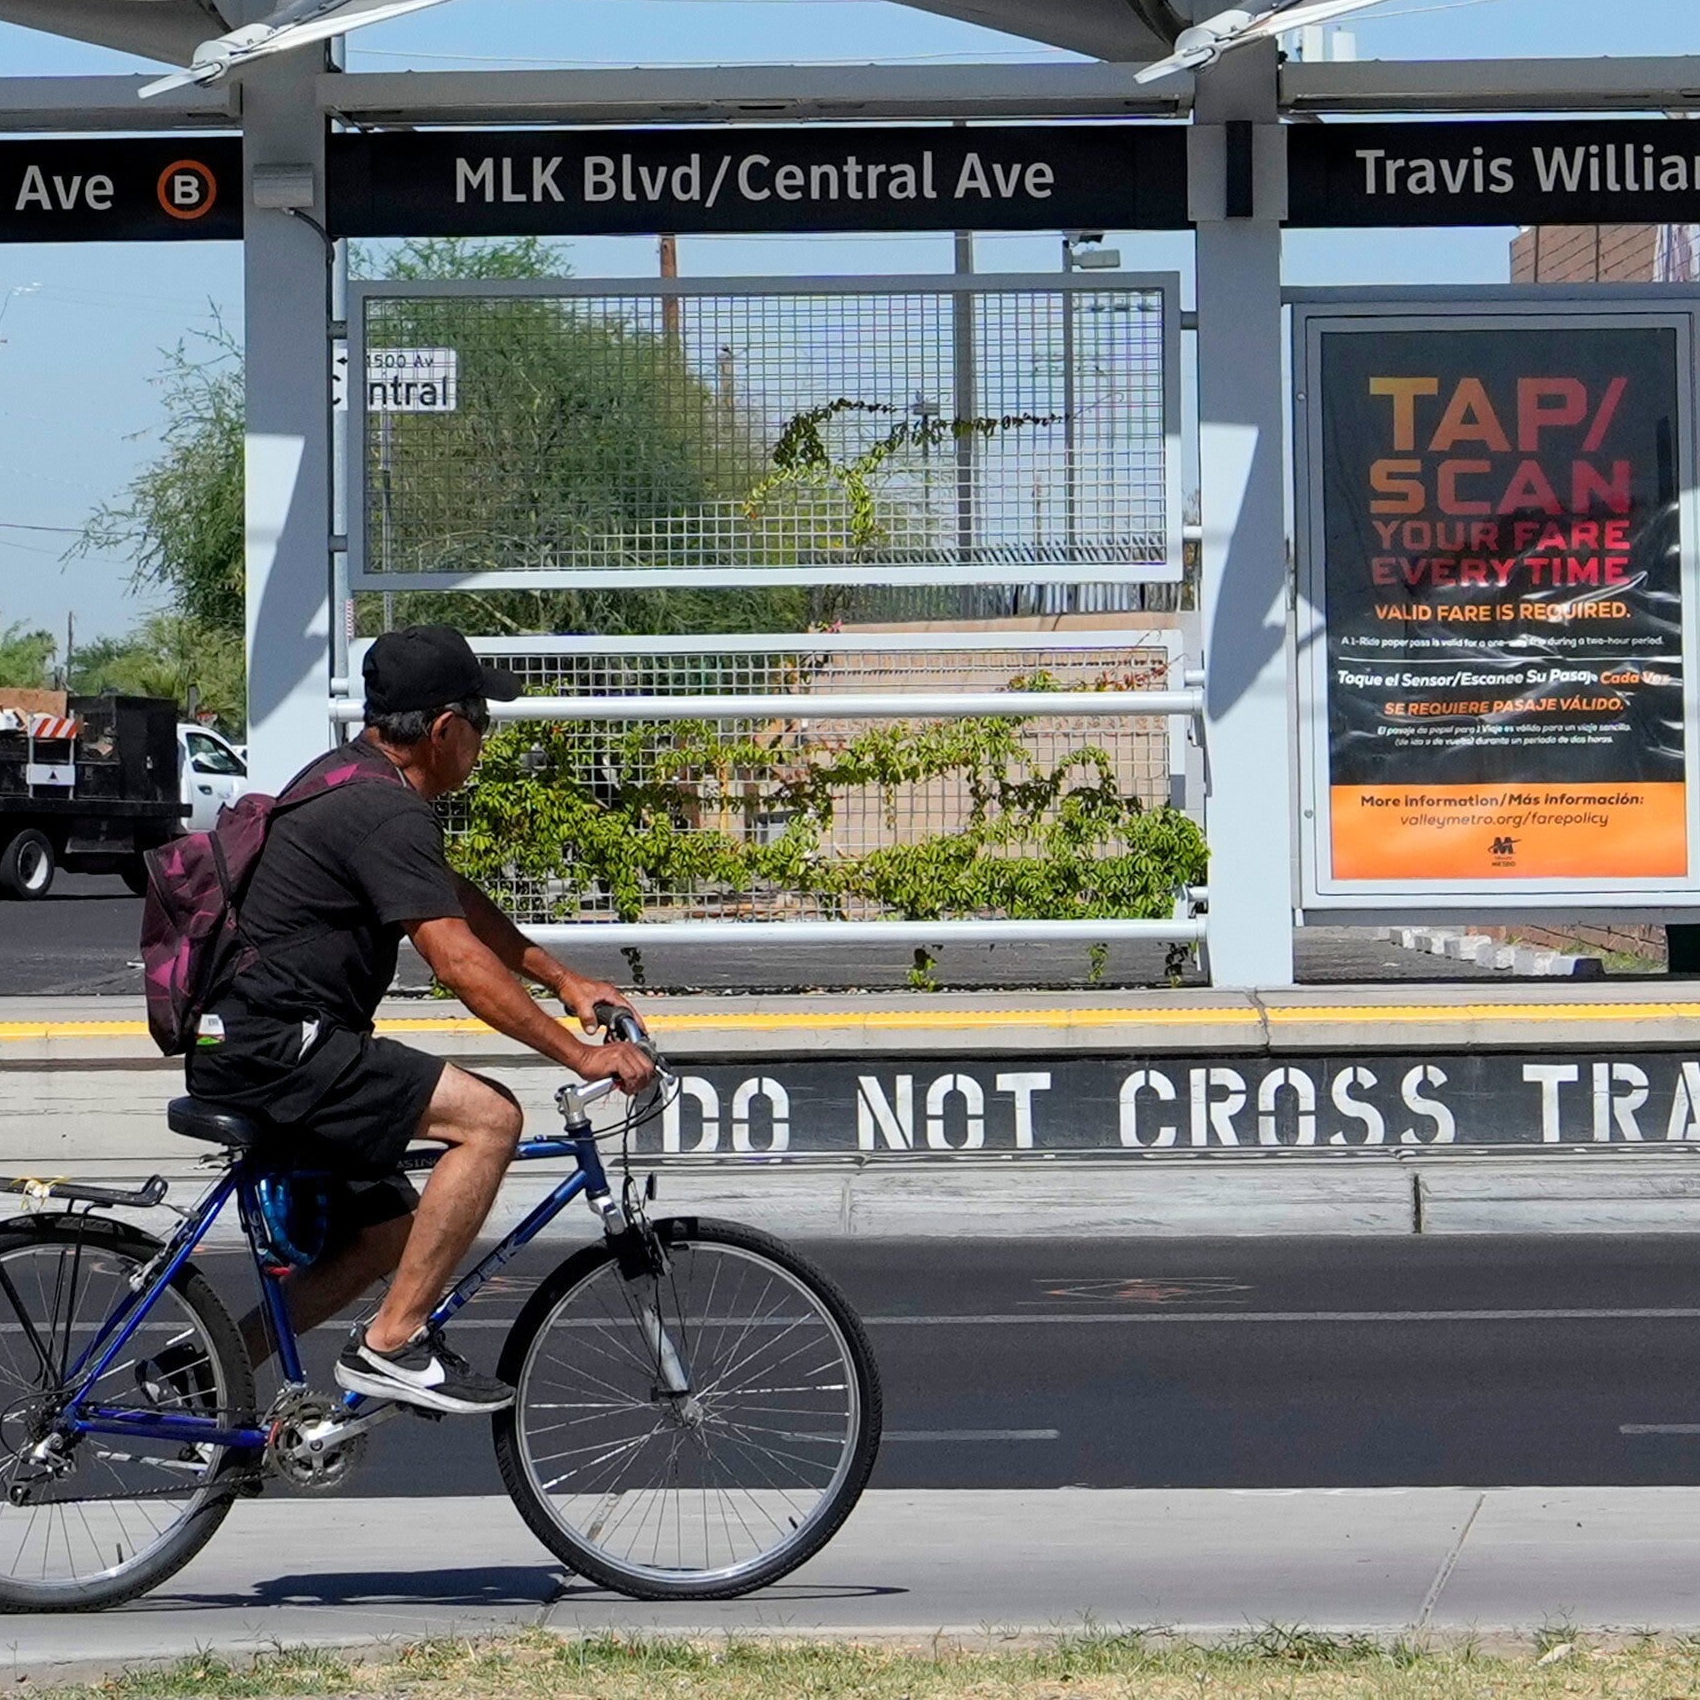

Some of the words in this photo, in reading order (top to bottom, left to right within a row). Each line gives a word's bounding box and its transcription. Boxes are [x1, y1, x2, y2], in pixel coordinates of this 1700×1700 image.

[456, 157, 565, 203] MLK
[584, 151, 937, 208] Blvd/Central
[954, 153, 1054, 198] Ave
[1355, 146, 1514, 194] Travis
[15, 165, 114, 210] Ave
[174, 175, 200, 204] B
[333, 374, 447, 406] ntral
[1369, 376, 1629, 452] TAP/
[1369, 459, 1630, 515] SCAN
[1372, 520, 1499, 552] YOUR
[1514, 520, 1630, 551] FARE
[1373, 557, 1515, 587] EVERY
[1523, 556, 1630, 586] TIME
[1375, 603, 1431, 621] VALID
[1437, 603, 1491, 621] FARE
[1496, 603, 1514, 621] IS
[1520, 601, 1631, 621] REQUIRED.
[1337, 670, 1382, 688] Toque
[1385, 672, 1399, 686] el
[1401, 671, 1523, 687] Sensor/Escanee
[1526, 669, 1547, 684] Su
[1550, 668, 1598, 685] Pasaje
[1600, 671, 1640, 684] Cada
[1384, 702, 1405, 715] SE
[1408, 701, 1490, 715] REQUIERE
[1492, 698, 1557, 713] PASAJE
[1560, 694, 1624, 711] VÁLIDO.
[1361, 795, 1401, 807] More
[1401, 811, 1609, 829] valleymetro.org/farepolicy
[662, 1076, 790, 1153] DO
[857, 1071, 1051, 1151] NOT
[1119, 1064, 1456, 1148] CROSS
